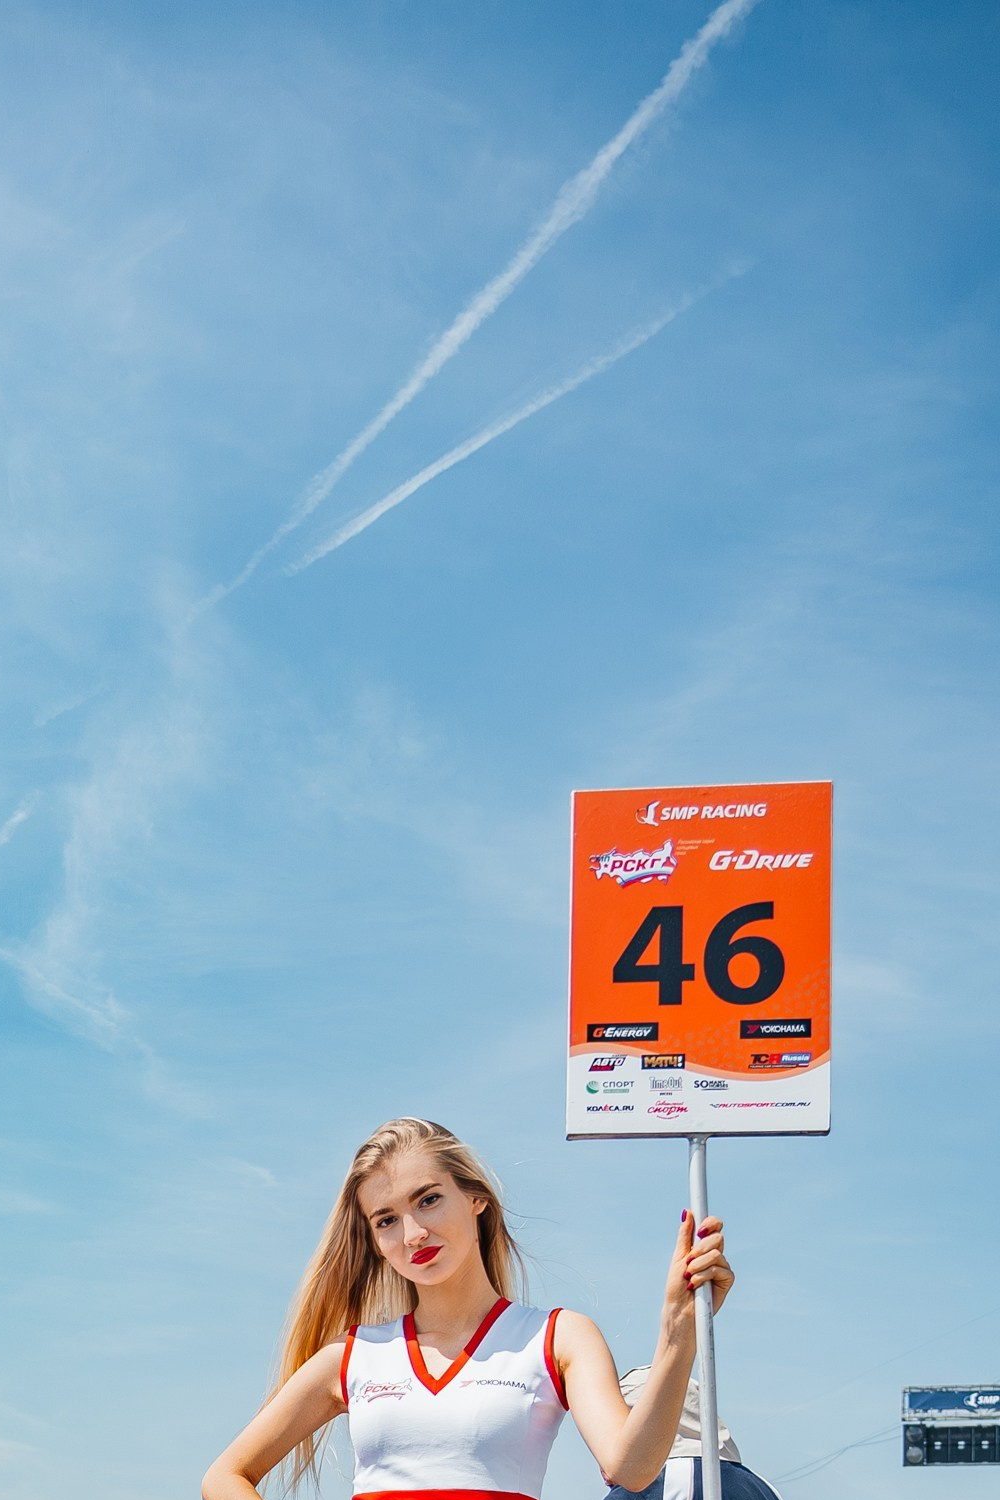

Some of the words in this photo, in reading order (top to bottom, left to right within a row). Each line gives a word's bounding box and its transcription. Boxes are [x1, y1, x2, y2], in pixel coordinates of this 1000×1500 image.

[660, 805, 699, 821] SMP
[700, 803, 767, 819] RACING
[610, 858, 662, 873] РСКГ
[613, 900, 786, 1006] 46
[759, 1024, 805, 1033] YOKOHAMA
[781, 1053, 810, 1062] Russia
[603, 1080, 635, 1088] СПОРТ
[694, 1080, 709, 1089] SO
[475, 1379, 527, 1391] YOKOHAMA
